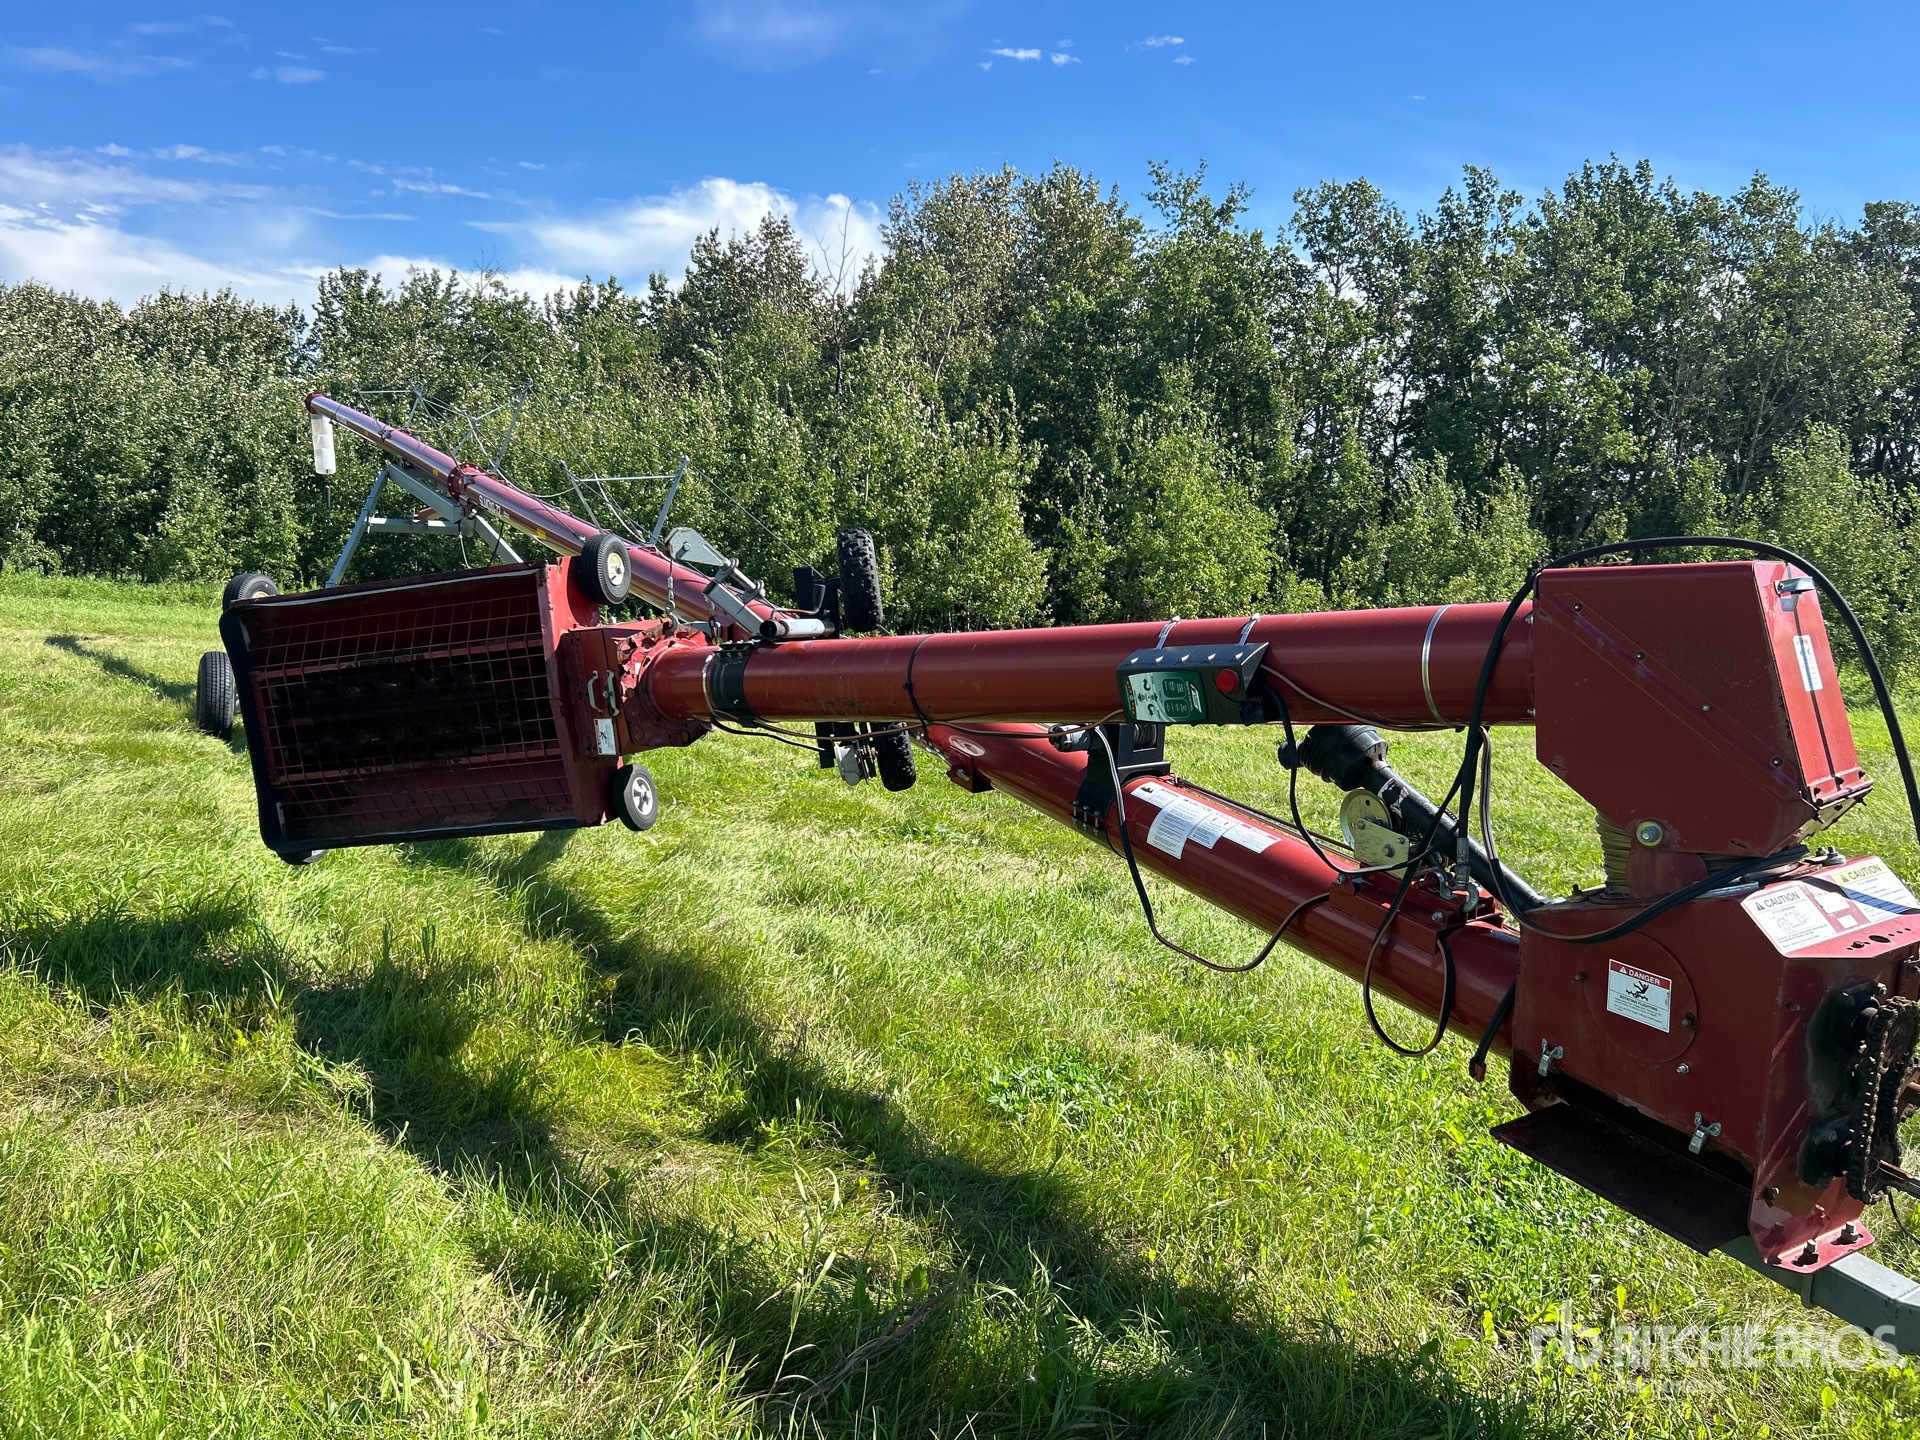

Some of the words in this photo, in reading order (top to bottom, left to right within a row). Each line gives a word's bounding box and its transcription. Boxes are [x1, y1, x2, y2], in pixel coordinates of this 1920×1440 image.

[1848, 864, 1882, 880] CAUTION
[1764, 891, 1800, 908] CAUTION
[1629, 969, 1660, 985] DANGER
